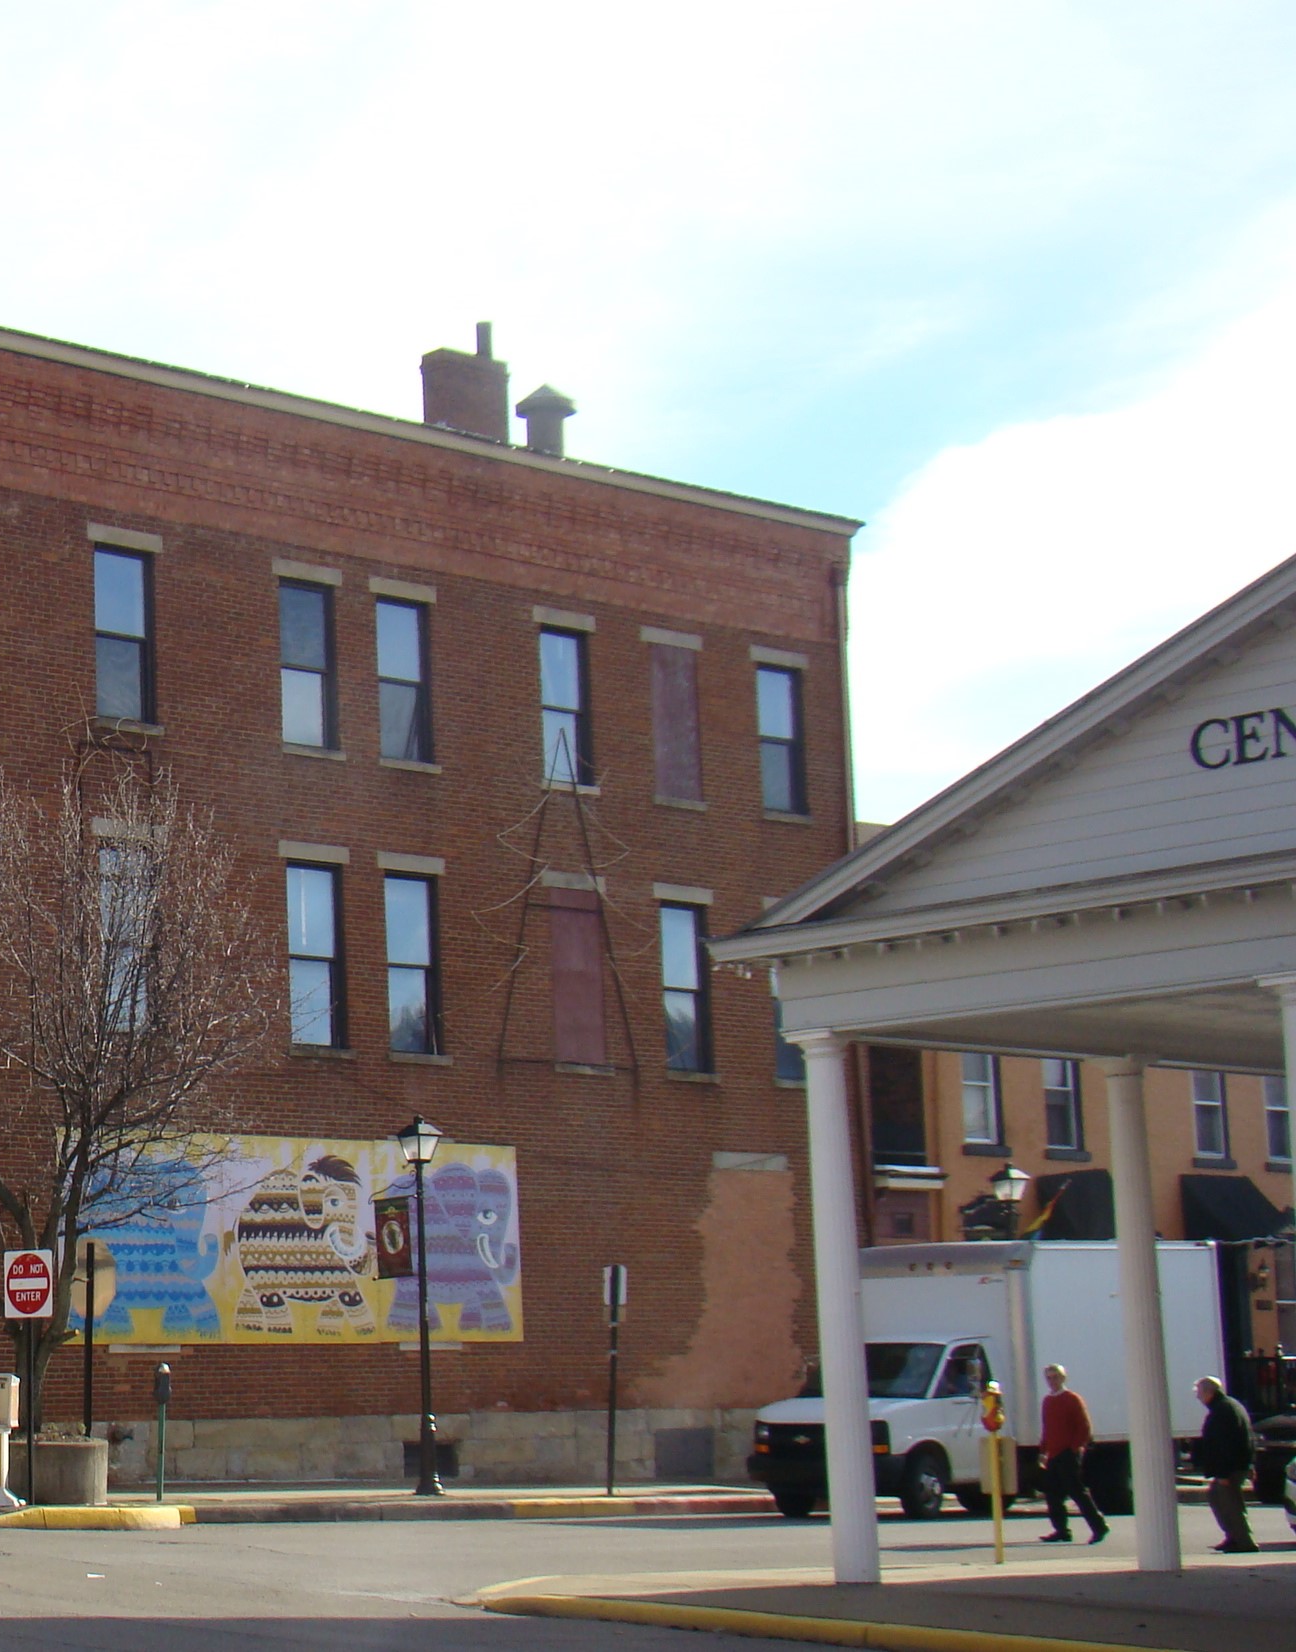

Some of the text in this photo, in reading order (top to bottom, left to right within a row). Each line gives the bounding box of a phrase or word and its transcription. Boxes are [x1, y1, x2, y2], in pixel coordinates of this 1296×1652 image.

[12, 1264, 44, 1275] DO NOT
[15, 1291, 41, 1302] ENTER
